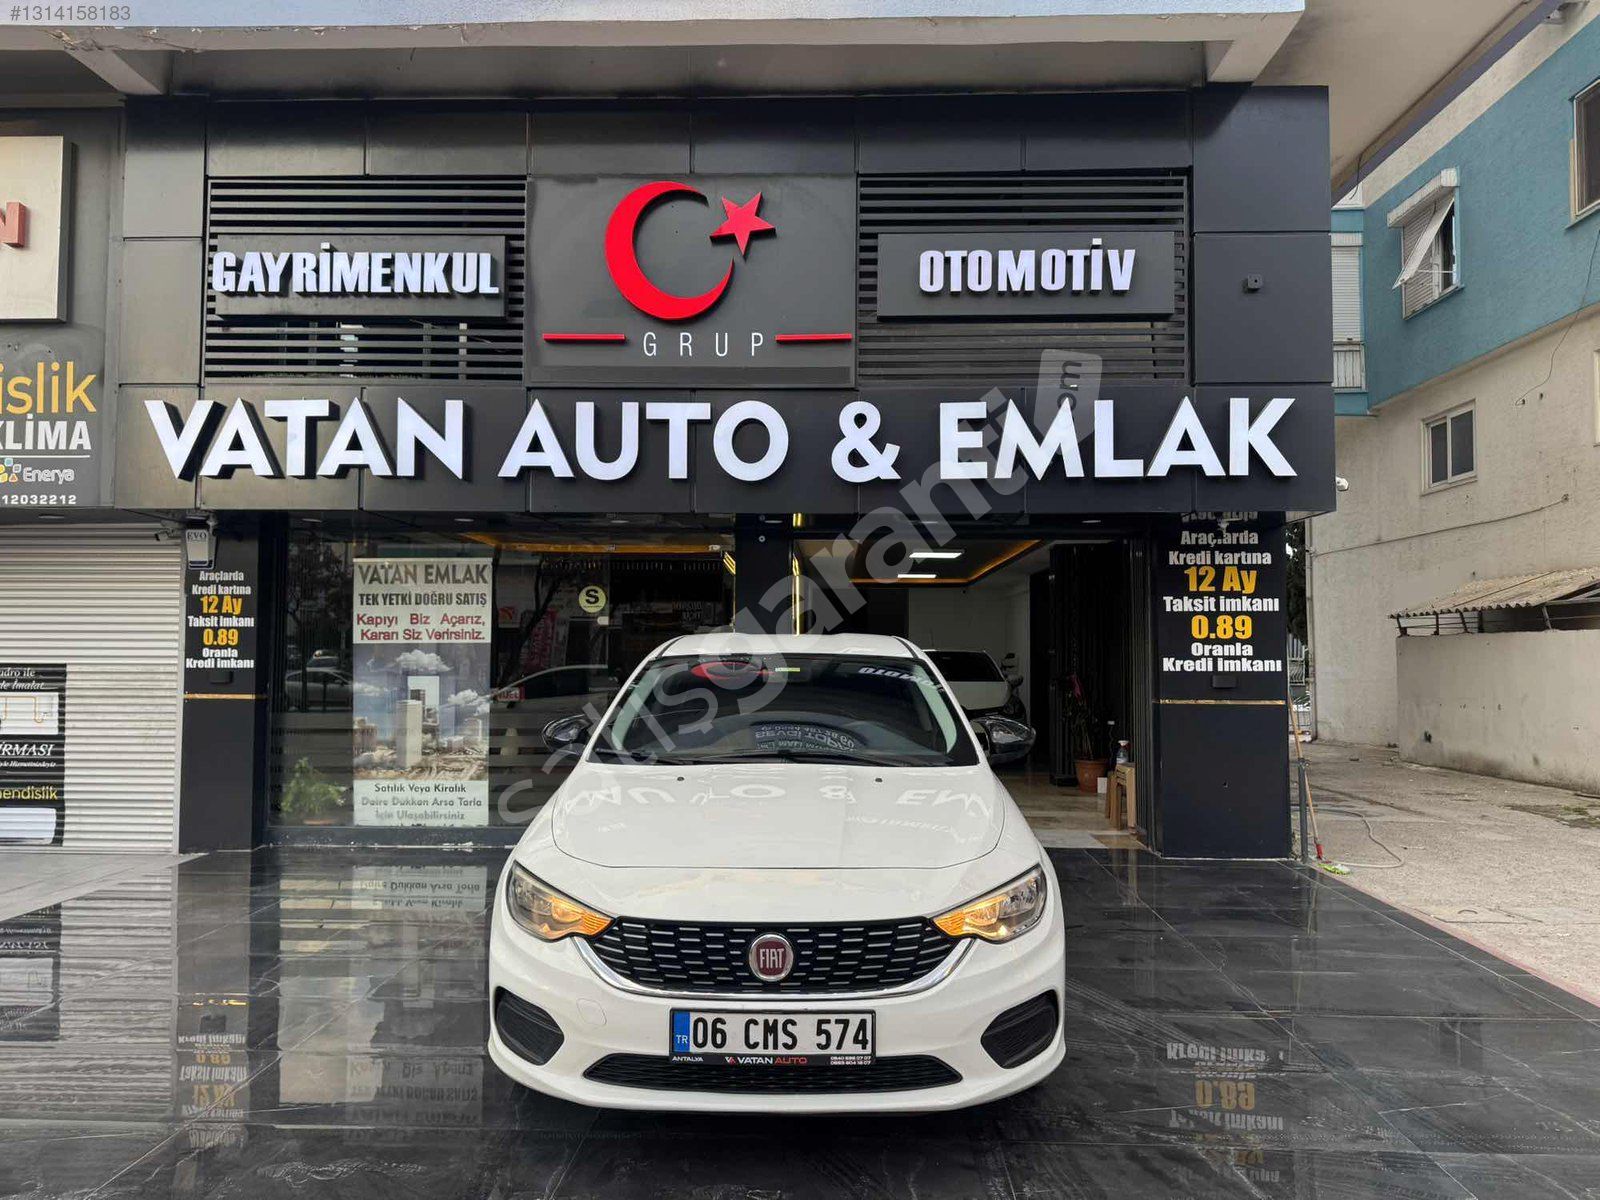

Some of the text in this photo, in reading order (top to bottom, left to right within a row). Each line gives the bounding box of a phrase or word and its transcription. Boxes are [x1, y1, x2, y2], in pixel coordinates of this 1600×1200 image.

[211, 242, 499, 294] GAYRİMENKUL
[919, 238, 1136, 292] OTOMOTİV
[643, 332, 764, 356] GRUP
[144, 396, 1298, 483] VATAN AUTO & EMLAK
[23, 467, 75, 484] Enerya
[1181, 531, 1259, 547] Araçarda
[1169, 551, 1272, 565] Kredi kartına
[199, 571, 244, 583] Araçlarda
[358, 565, 488, 585] VATAN EMLAK
[1184, 566, 1257, 594] 12 Ay
[192, 584, 251, 595] Kredi kartına
[201, 596, 242, 615] 12 Ay
[359, 591, 487, 607] TEK YETKİ DOĞRU SATIŞ
[1163, 596, 1279, 612] Taksit imkanı
[188, 616, 254, 627] Taksit imkanı
[357, 613, 485, 627] Kapıyı Biz Açarız,
[1191, 615, 1253, 639] 0.89
[203, 629, 238, 646] 0.89
[361, 629, 485, 640] Kararı Siz Verirsiniz.
[202, 648, 238, 658] Oranla
[1191, 642, 1253, 656] Oranla
[186, 658, 254, 669] Kredi imkanı
[1163, 658, 1282, 672] Kredi imkanı
[375, 783, 466, 794] Satılık Veya Kiralık
[432, 796, 454, 807] Arsa
[458, 796, 482, 807] Tarla
[760, 948, 785, 969] FIAT
[676, 1035, 688, 1045] TR
[692, 1017, 869, 1051] 06 CMS 574
[737, 1056, 807, 1065] VATAN AUTO
